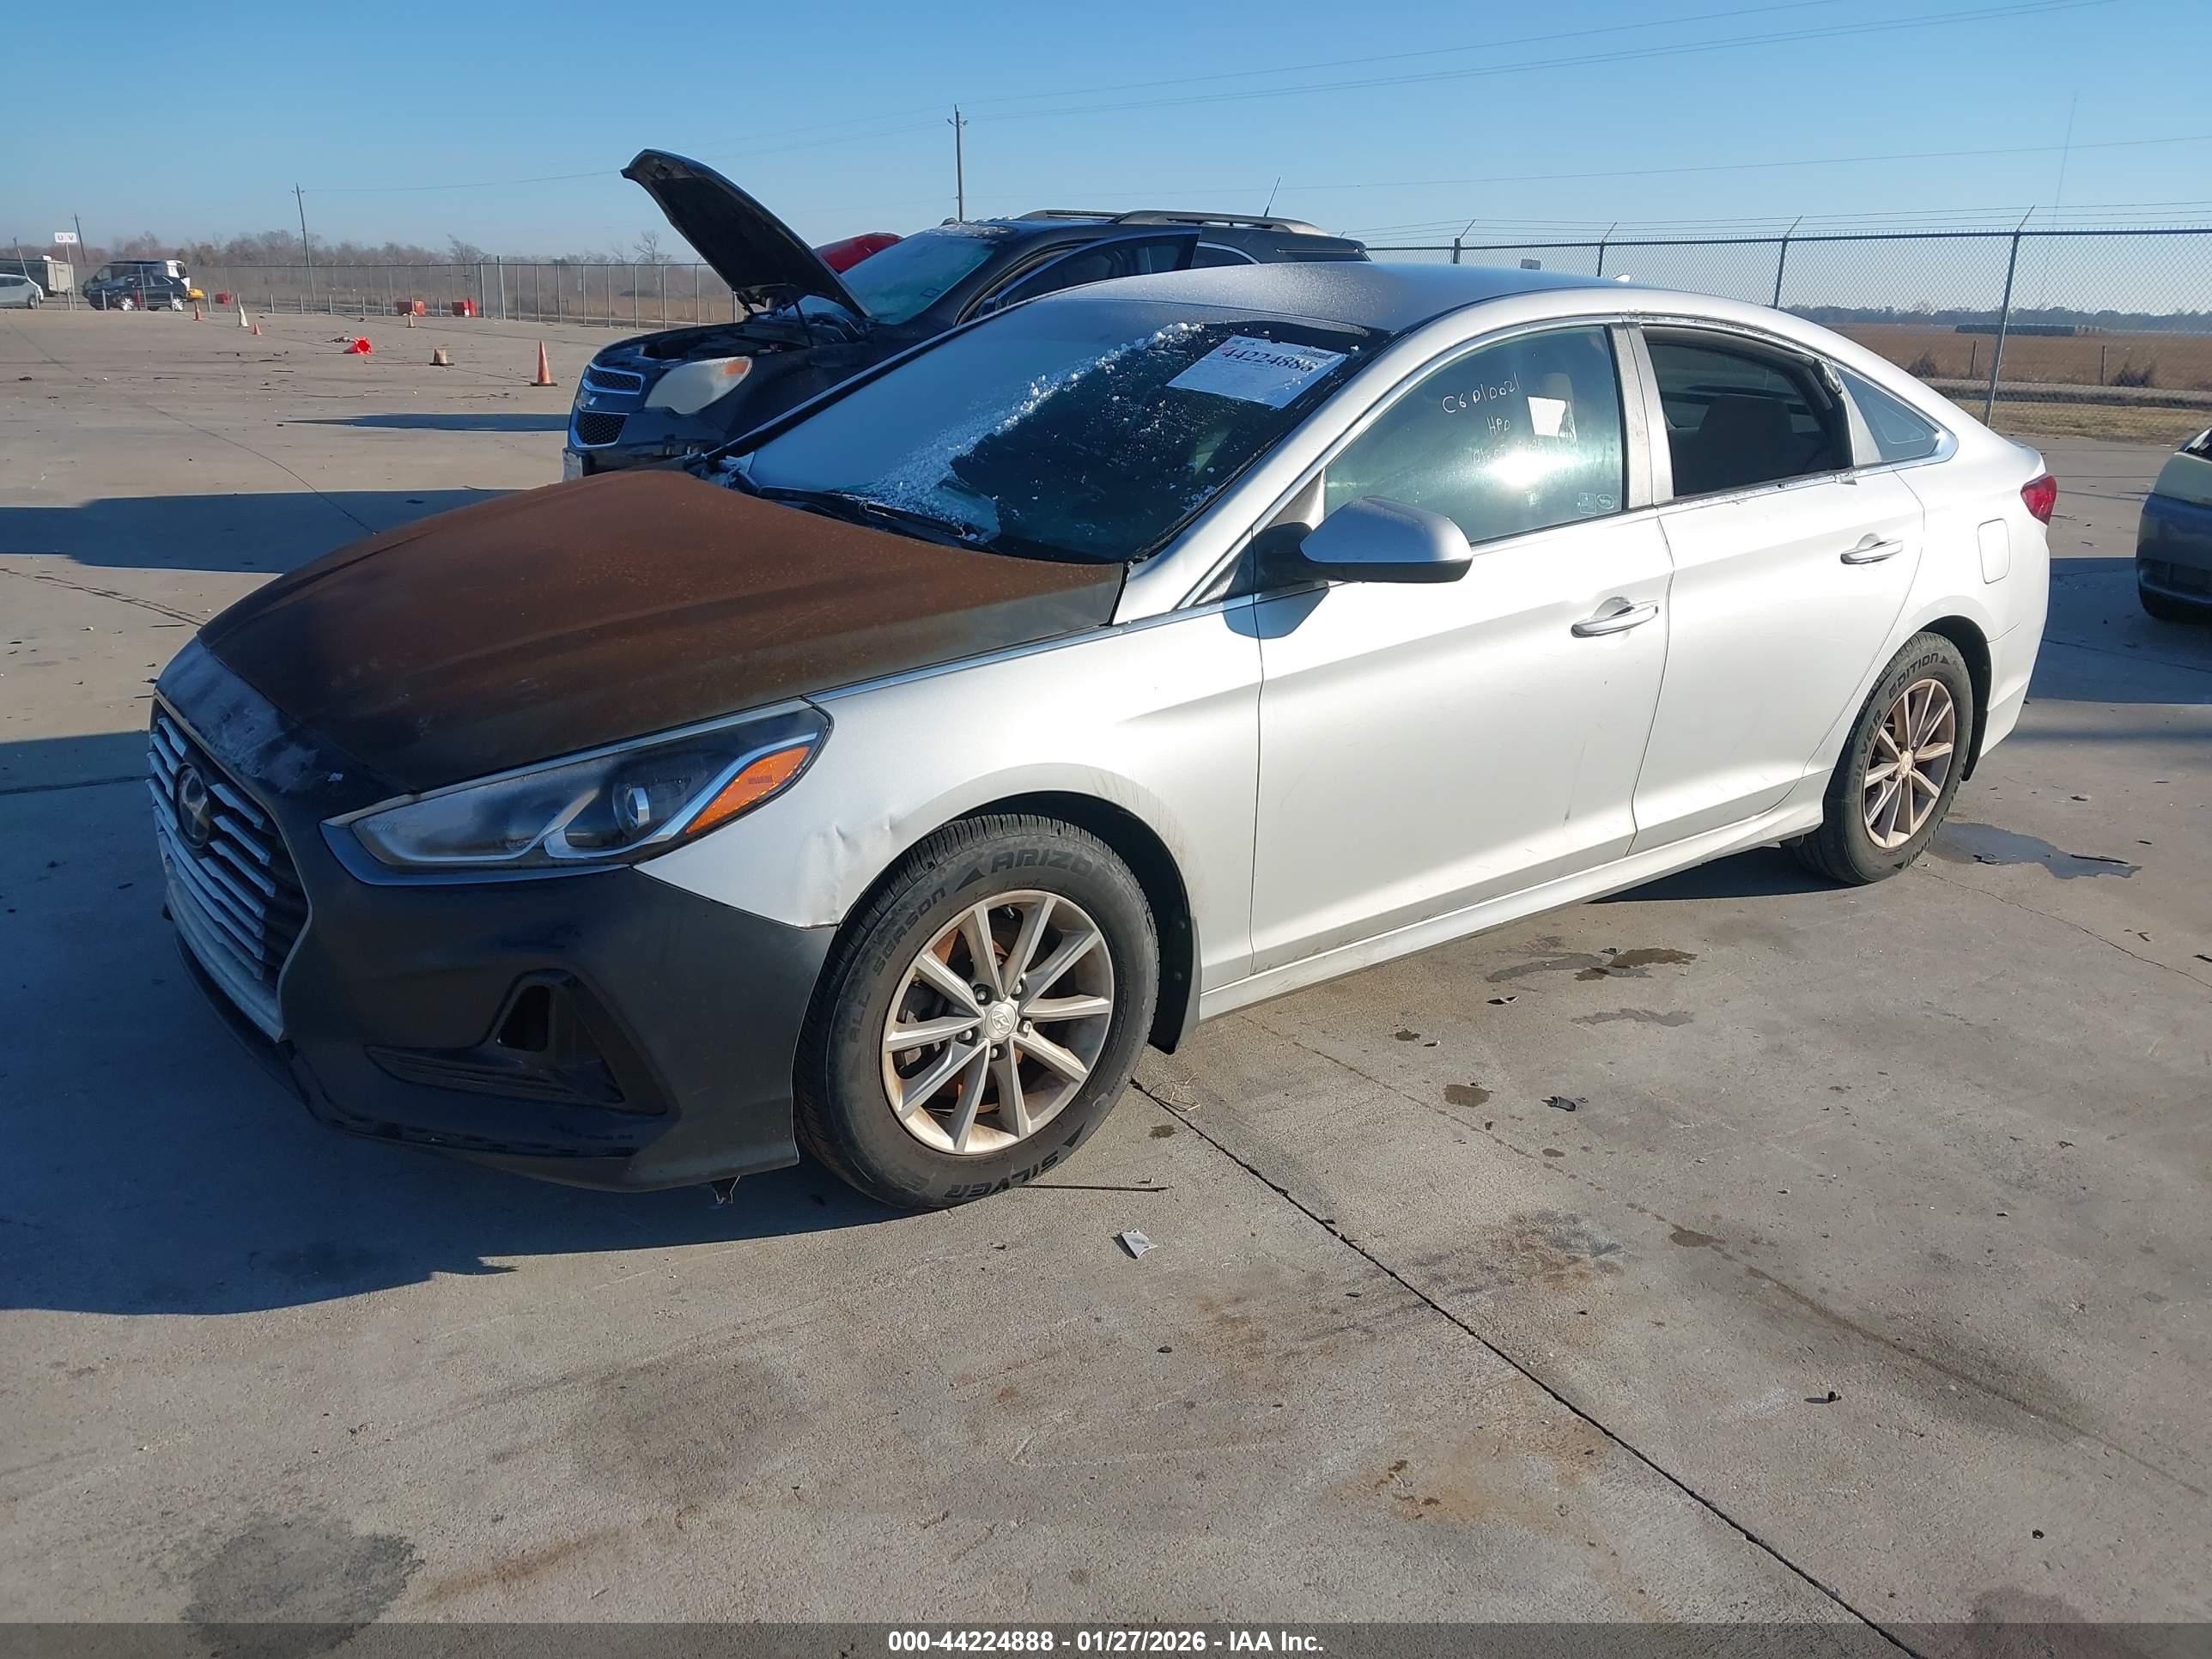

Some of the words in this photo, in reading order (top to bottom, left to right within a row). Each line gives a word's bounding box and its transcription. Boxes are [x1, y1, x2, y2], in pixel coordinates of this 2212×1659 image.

[1222, 348, 1319, 372] 44224888
[1486, 415, 1510, 435] HPD
[1888, 652, 1939, 700] EDITION
[1853, 708, 1883, 788] SILVER
[872, 885, 945, 977] SEASON
[945, 1150, 1059, 1199] SILVER
